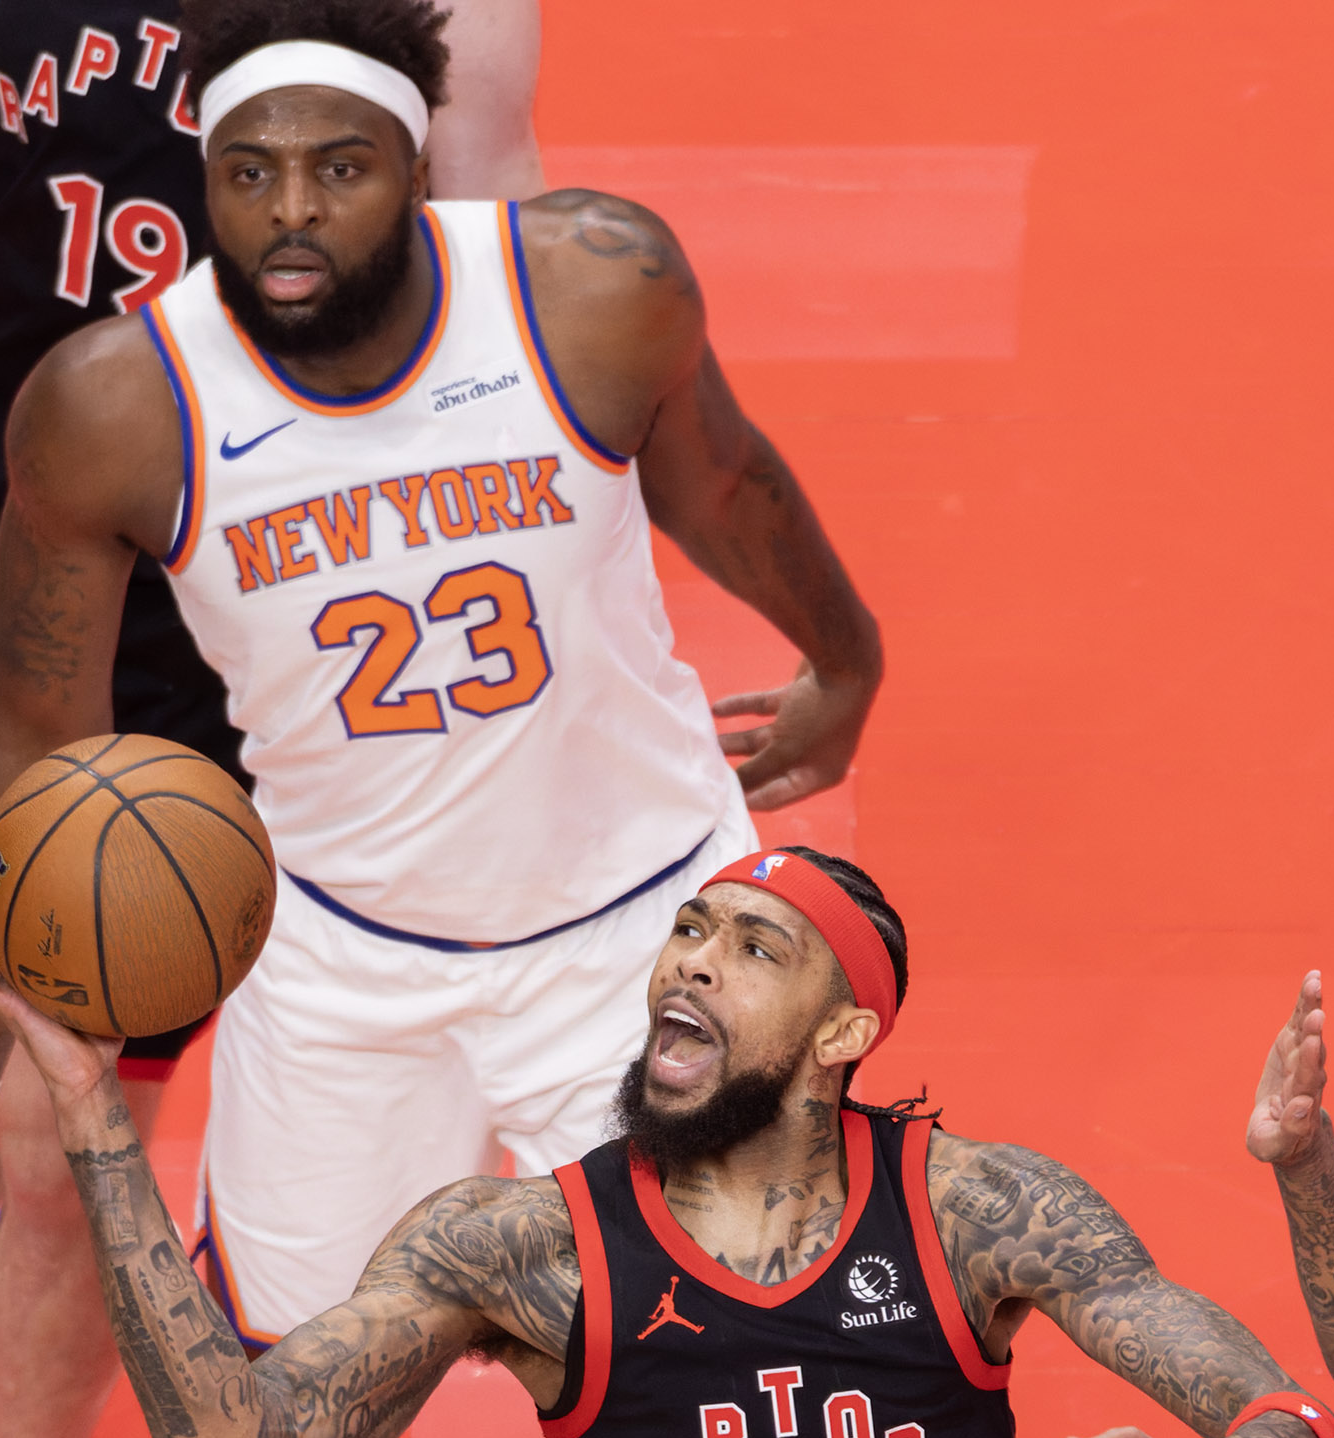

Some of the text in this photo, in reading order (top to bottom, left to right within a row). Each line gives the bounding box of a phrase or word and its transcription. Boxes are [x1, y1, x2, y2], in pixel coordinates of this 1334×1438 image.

[47, 174, 189, 315] 19
[434, 370, 521, 412] abu dhabi
[222, 453, 575, 596] NEW YORK
[310, 560, 554, 740] 23
[841, 1301, 918, 1329] Sun Life
